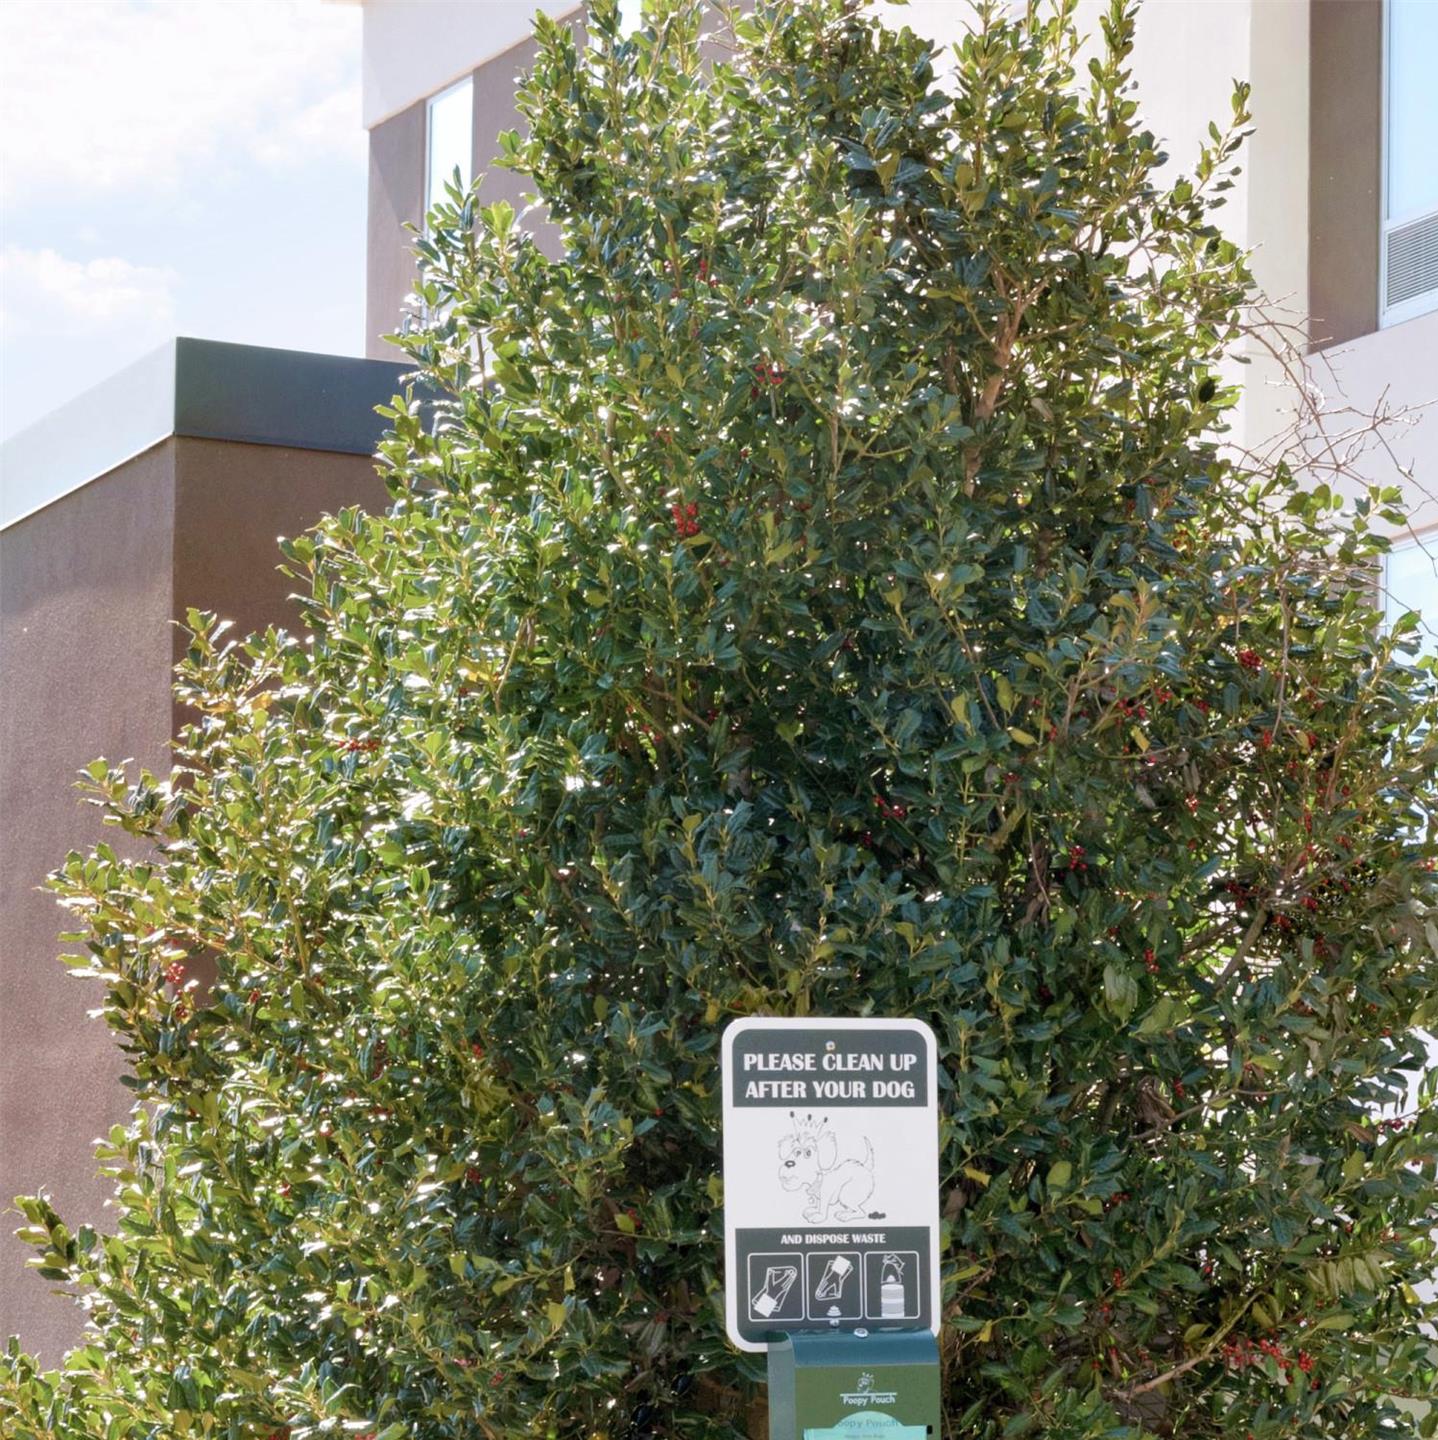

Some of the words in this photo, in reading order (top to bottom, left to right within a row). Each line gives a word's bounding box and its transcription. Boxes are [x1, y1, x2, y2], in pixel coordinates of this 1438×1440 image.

[743, 1053, 817, 1071] PLEASE
[822, 1053, 884, 1071] CLEAN
[890, 1053, 917, 1071] UP
[745, 1080, 807, 1099] AFTER
[812, 1080, 866, 1099] YOUR
[872, 1080, 916, 1099] DOG
[780, 1234, 802, 1245] AND
[804, 1233, 850, 1244] DISPOSE
[851, 1233, 887, 1244] WASTE
[843, 1396, 868, 1406] Poopy
[870, 1395, 896, 1404] Pouch
